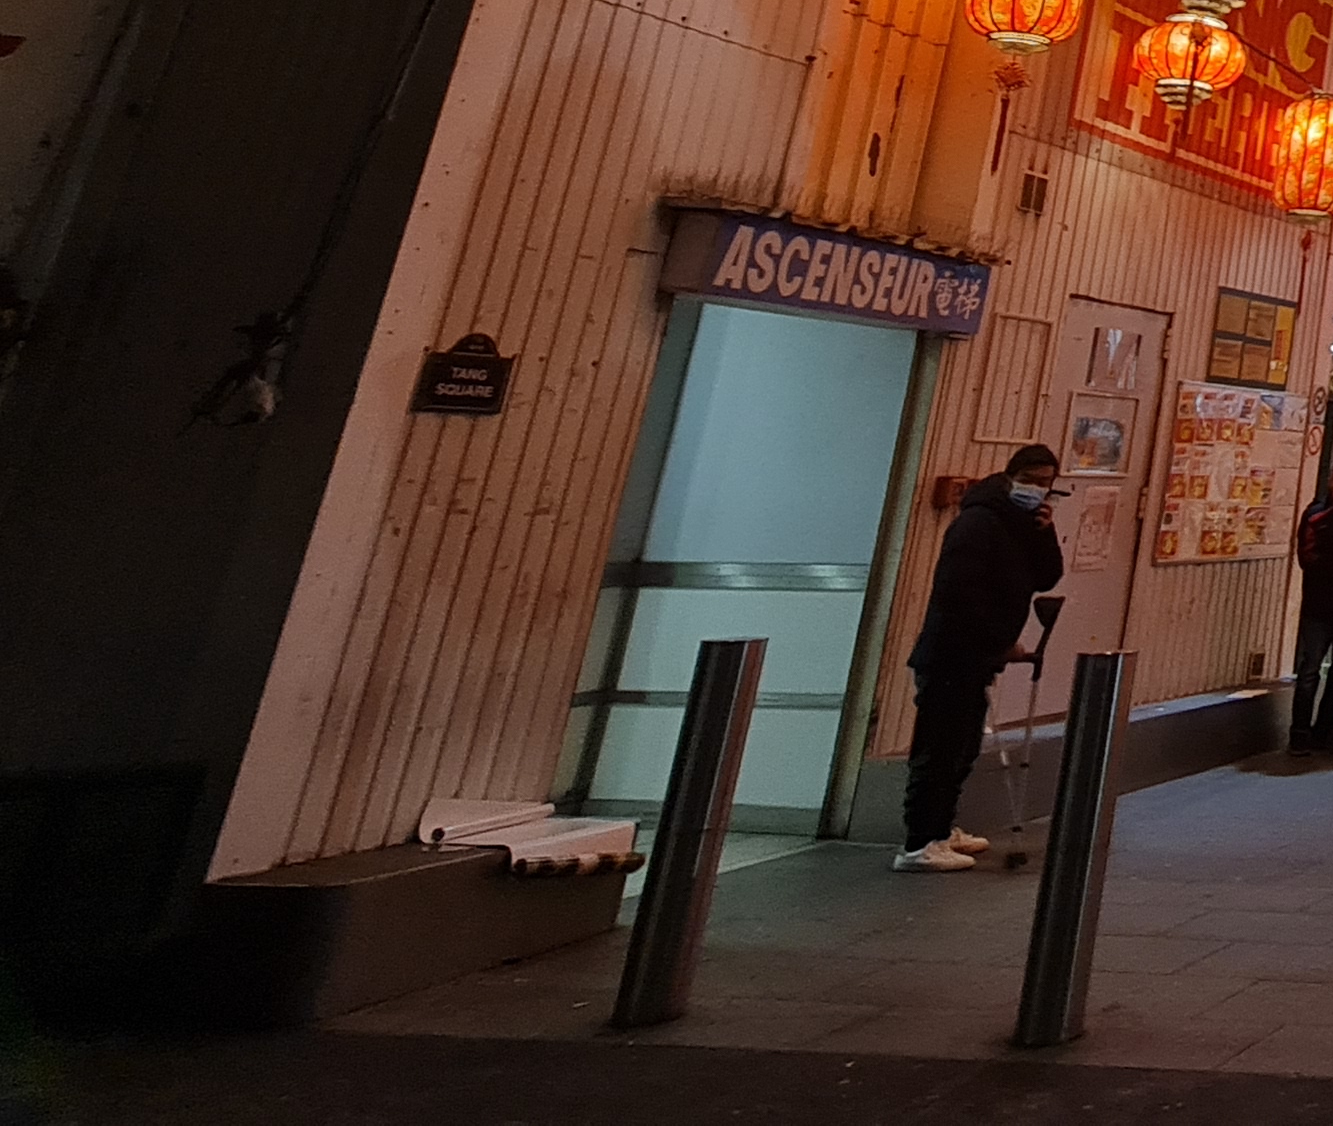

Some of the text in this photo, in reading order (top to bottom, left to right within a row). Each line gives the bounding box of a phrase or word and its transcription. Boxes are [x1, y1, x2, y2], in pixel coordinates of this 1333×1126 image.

[712, 224, 936, 319] ASCENSEUR
[934, 270, 981, 320] 電梯
[450, 365, 489, 382] TANG
[434, 382, 495, 399] SQUARE
